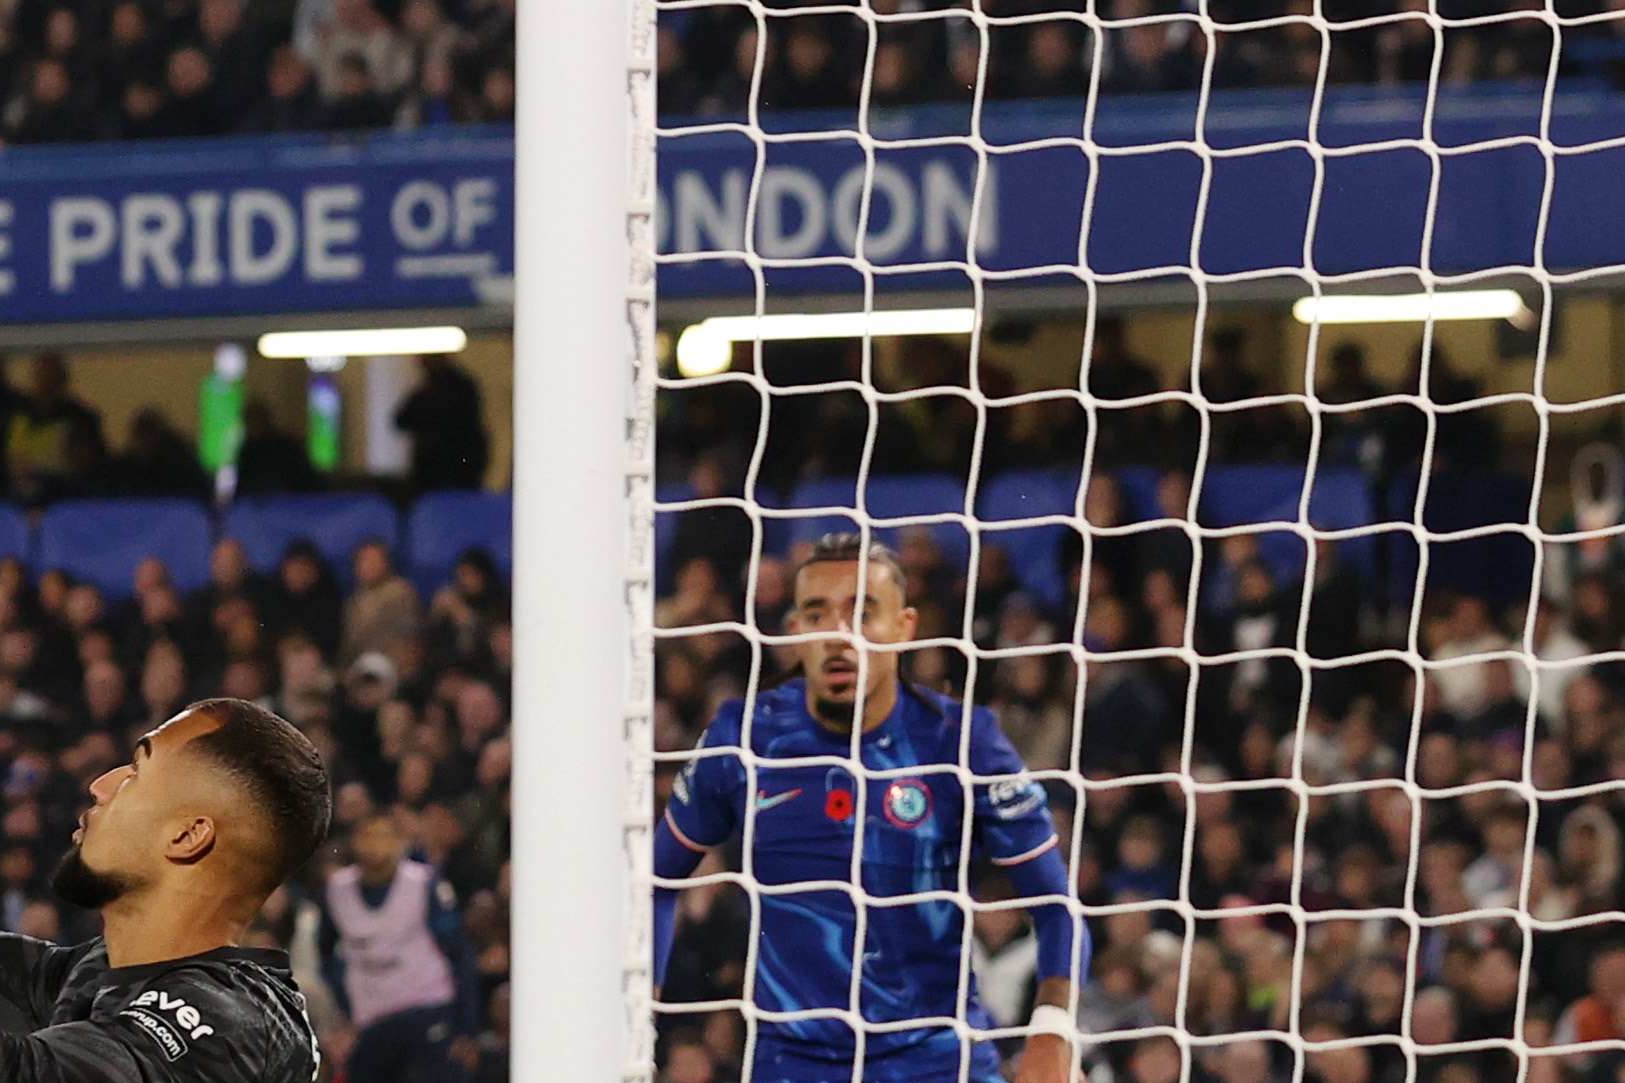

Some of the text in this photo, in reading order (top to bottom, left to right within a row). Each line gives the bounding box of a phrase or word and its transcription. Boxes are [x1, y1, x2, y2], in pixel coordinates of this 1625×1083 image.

[50, 184, 365, 291] PRIDE
[389, 178, 495, 250] OF
[656, 158, 1000, 267] NDON
[129, 990, 214, 1041] ever
